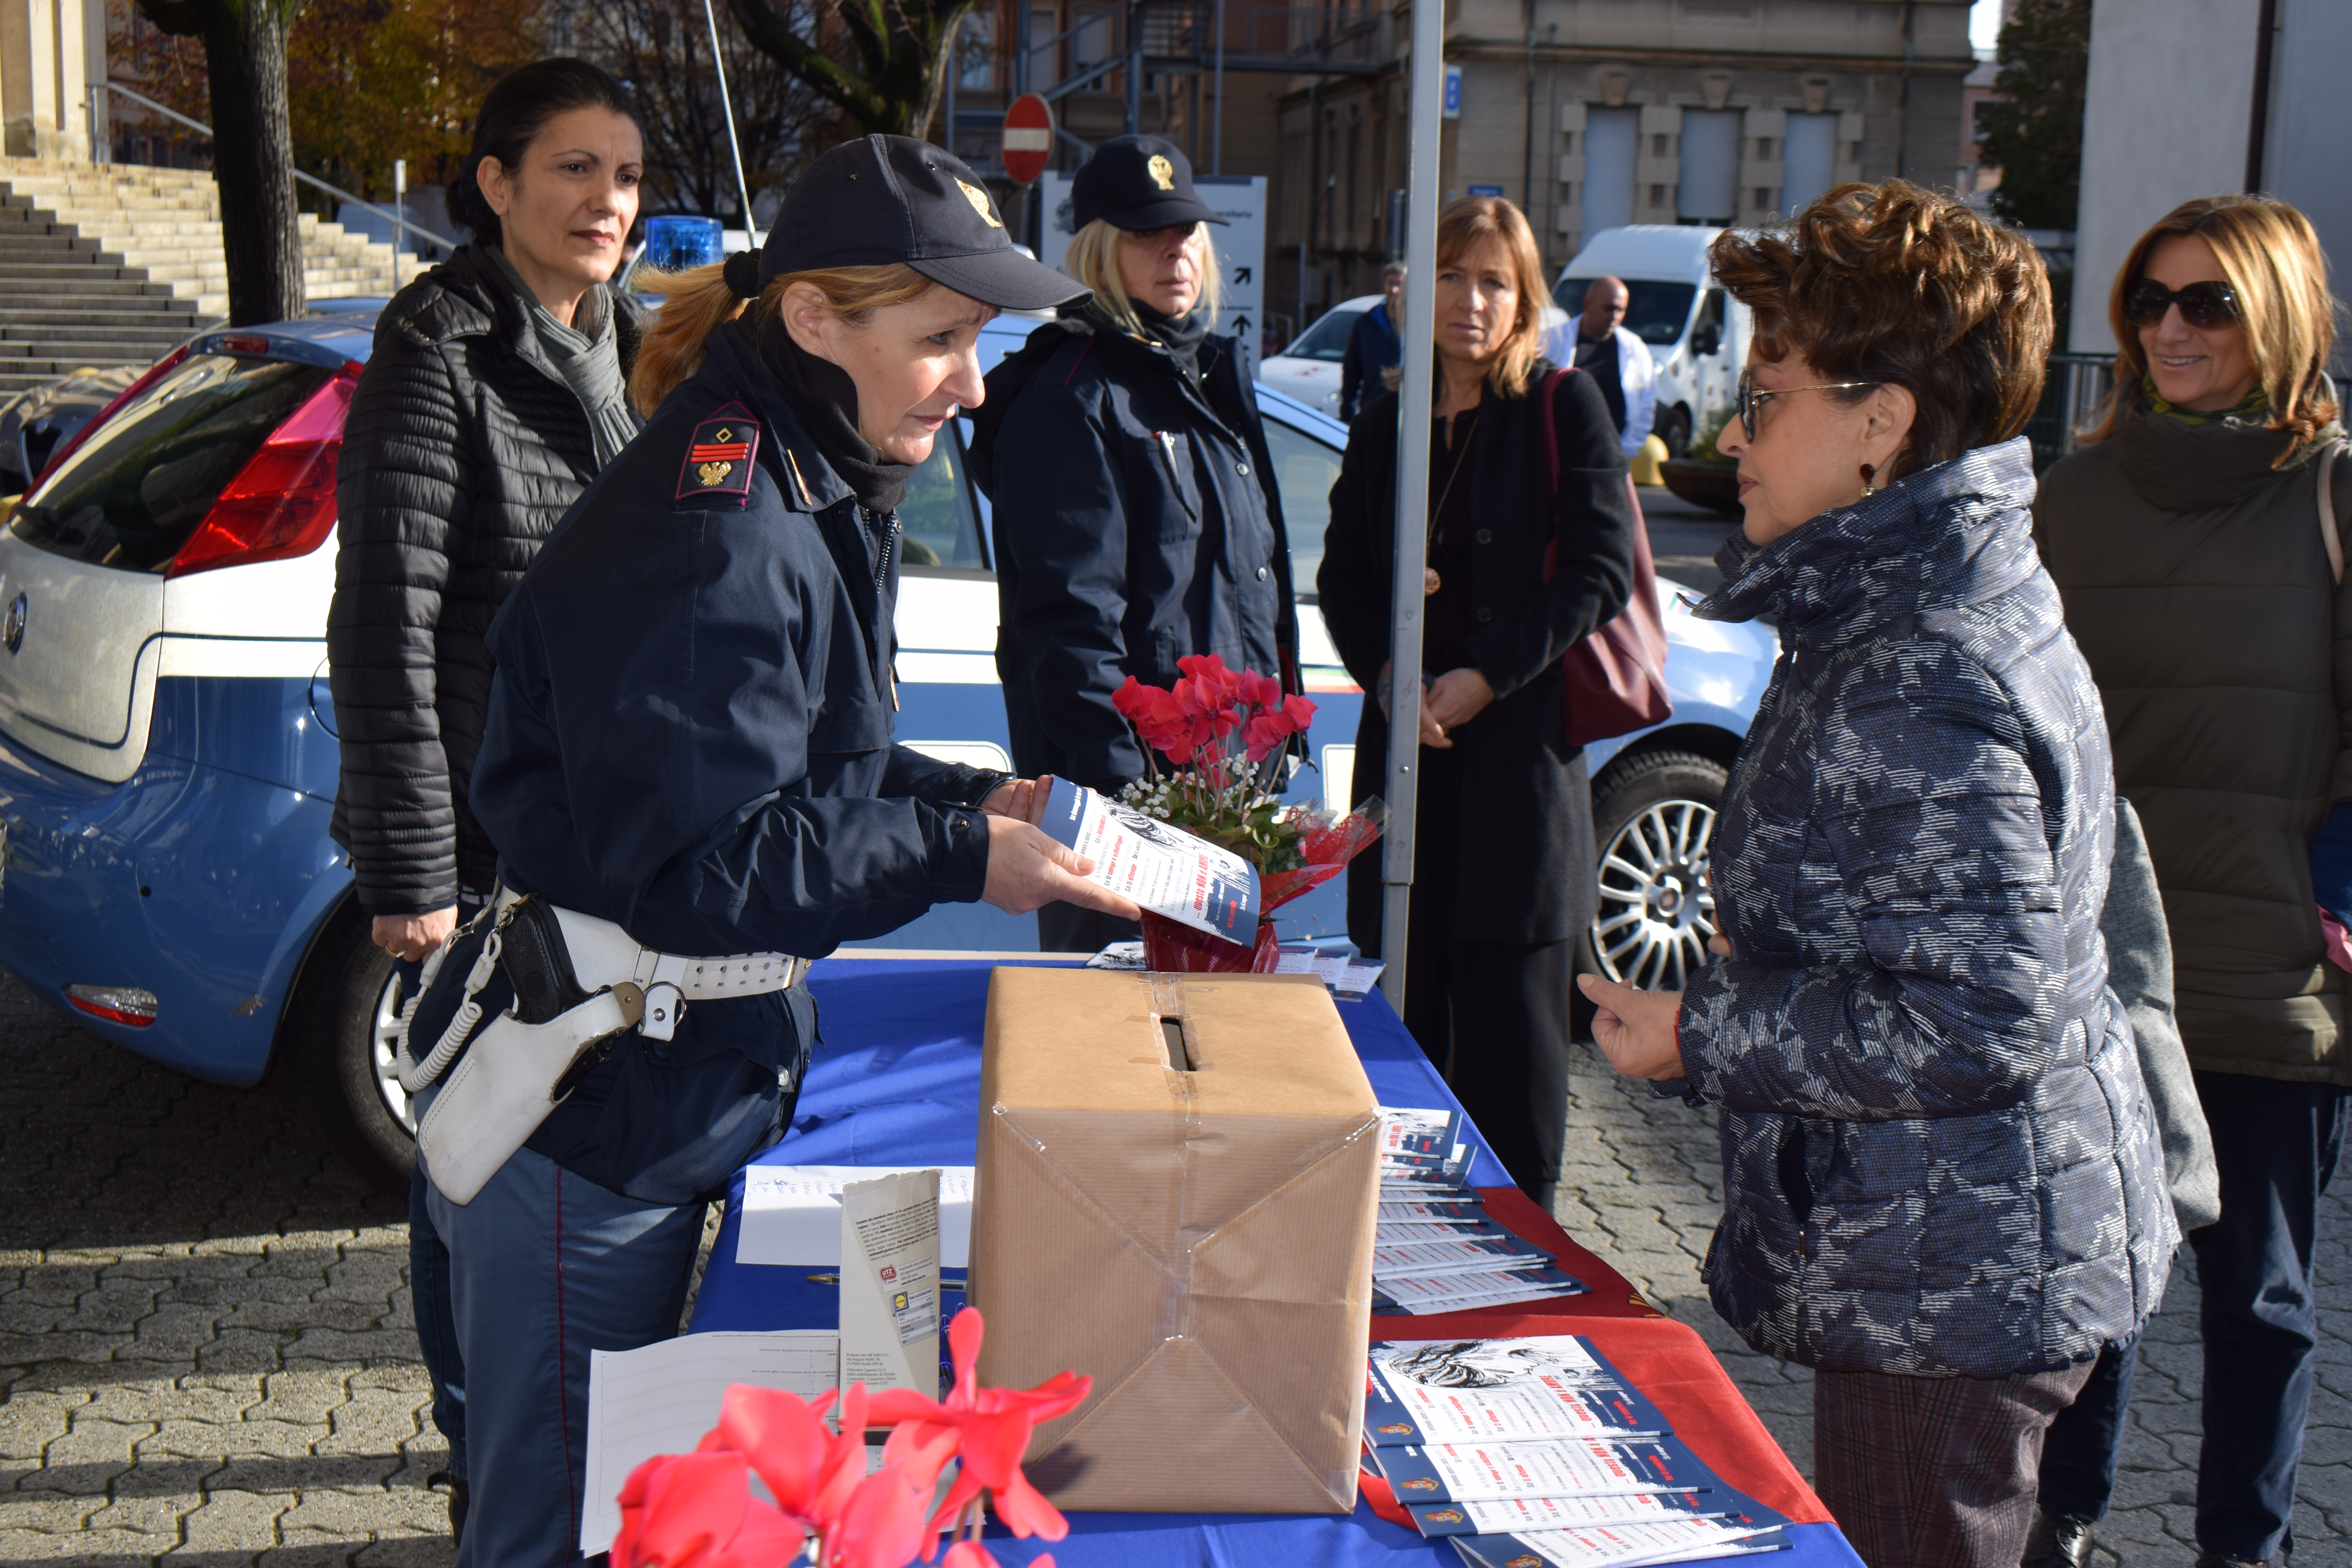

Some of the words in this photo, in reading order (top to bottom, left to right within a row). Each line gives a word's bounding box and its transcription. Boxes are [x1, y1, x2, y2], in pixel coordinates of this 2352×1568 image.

[1107, 860, 1116, 876] spinge
[1127, 863, 1137, 881] offende
[1196, 874, 1207, 888] NON
[1194, 889, 1205, 910] questo
[1538, 1375, 1564, 1388] AMORE
[1557, 1394, 1577, 1402] NON
[1570, 1404, 1592, 1421] questo
[1590, 1447, 1611, 1457] NON
[1603, 1459, 1626, 1477] questo
